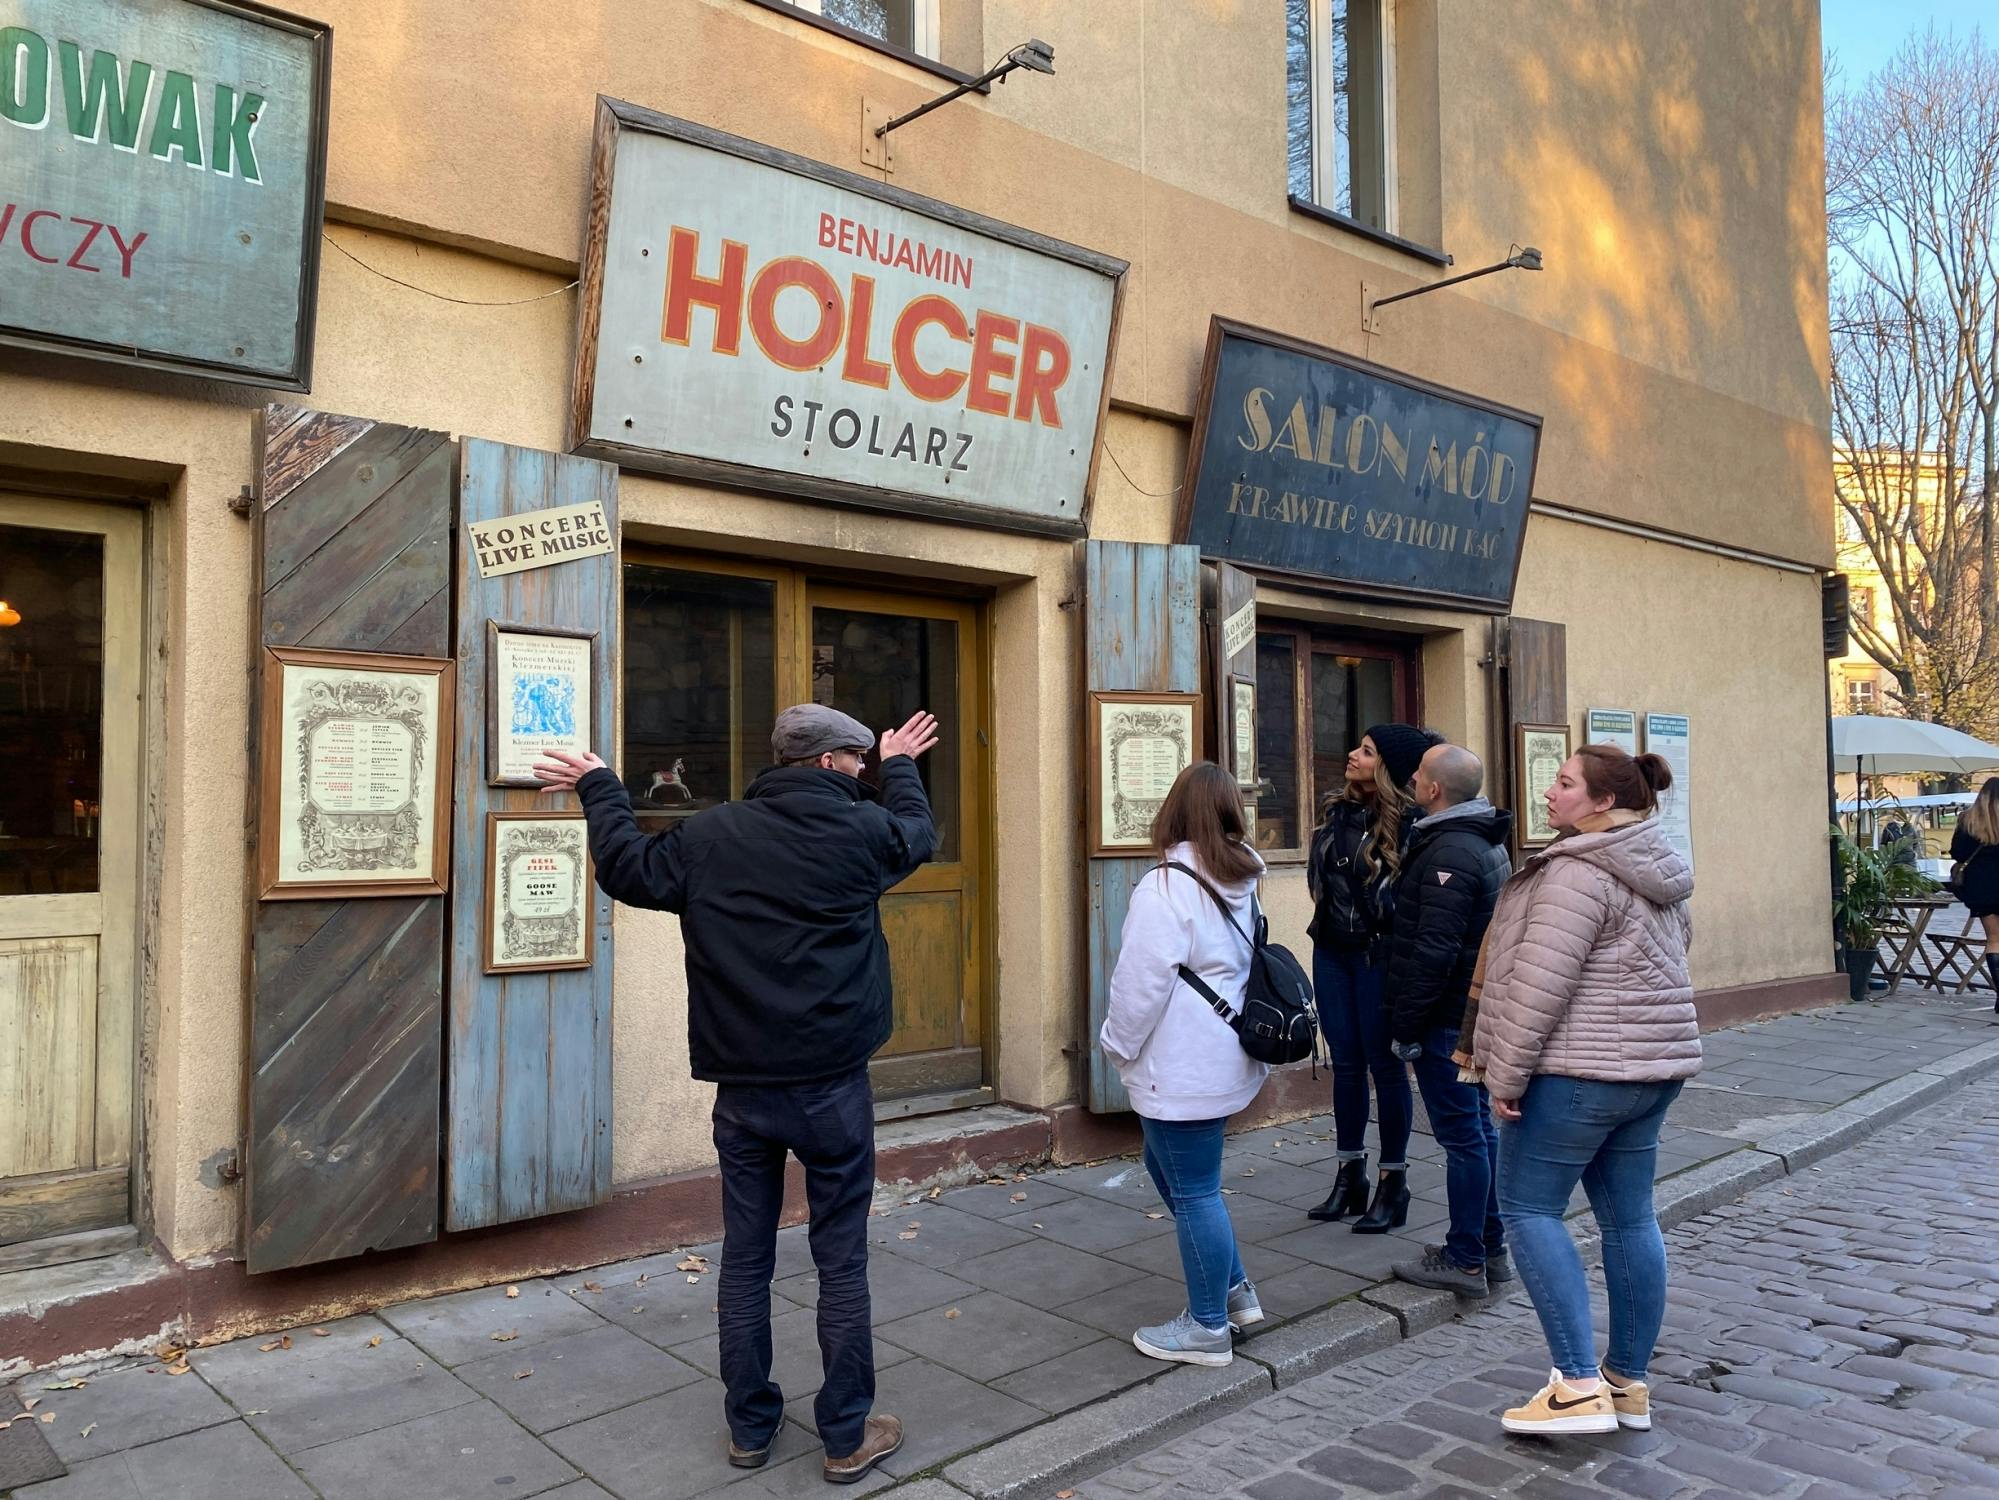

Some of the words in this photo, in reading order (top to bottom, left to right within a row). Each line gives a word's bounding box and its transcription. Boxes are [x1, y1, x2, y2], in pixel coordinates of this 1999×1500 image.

[818, 212, 974, 289] BENJAMIN
[661, 225, 1071, 429] HOLCER
[770, 395, 974, 472] STOLARZ
[1237, 387, 1413, 484] SALON
[1419, 431, 1517, 505] MÓD
[474, 512, 601, 549] KONCERT
[480, 543, 535, 568] LIVE
[541, 530, 609, 555] MUSIC
[1226, 482, 1358, 534] KRAWIEC
[1363, 509, 1457, 553] SZYMON
[1463, 529, 1501, 561] KAC
[1226, 608, 1254, 640] KONCERT
